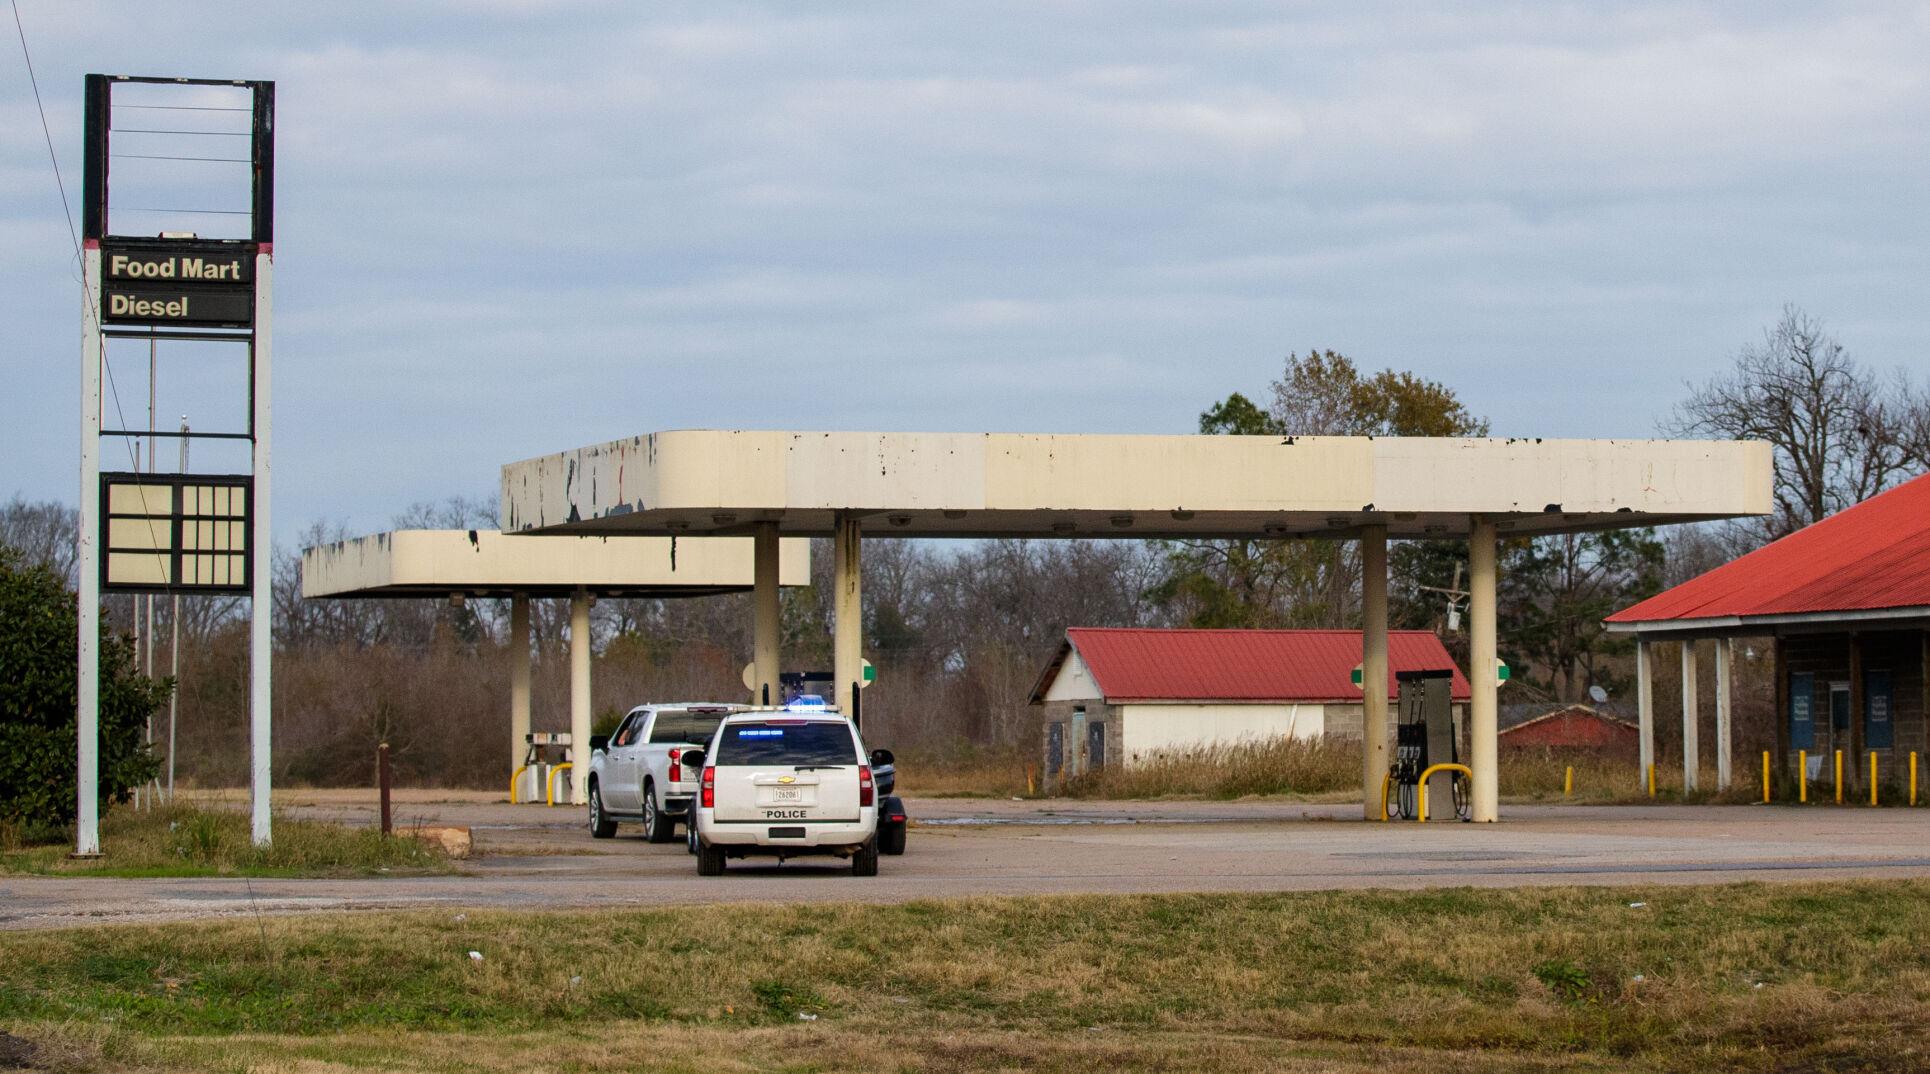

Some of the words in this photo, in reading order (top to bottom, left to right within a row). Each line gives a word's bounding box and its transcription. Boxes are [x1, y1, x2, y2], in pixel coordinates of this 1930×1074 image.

[112, 256, 175, 278] Food
[182, 258, 240, 280] Mart
[111, 295, 188, 317] Diesel
[766, 810, 807, 818] POLICE
